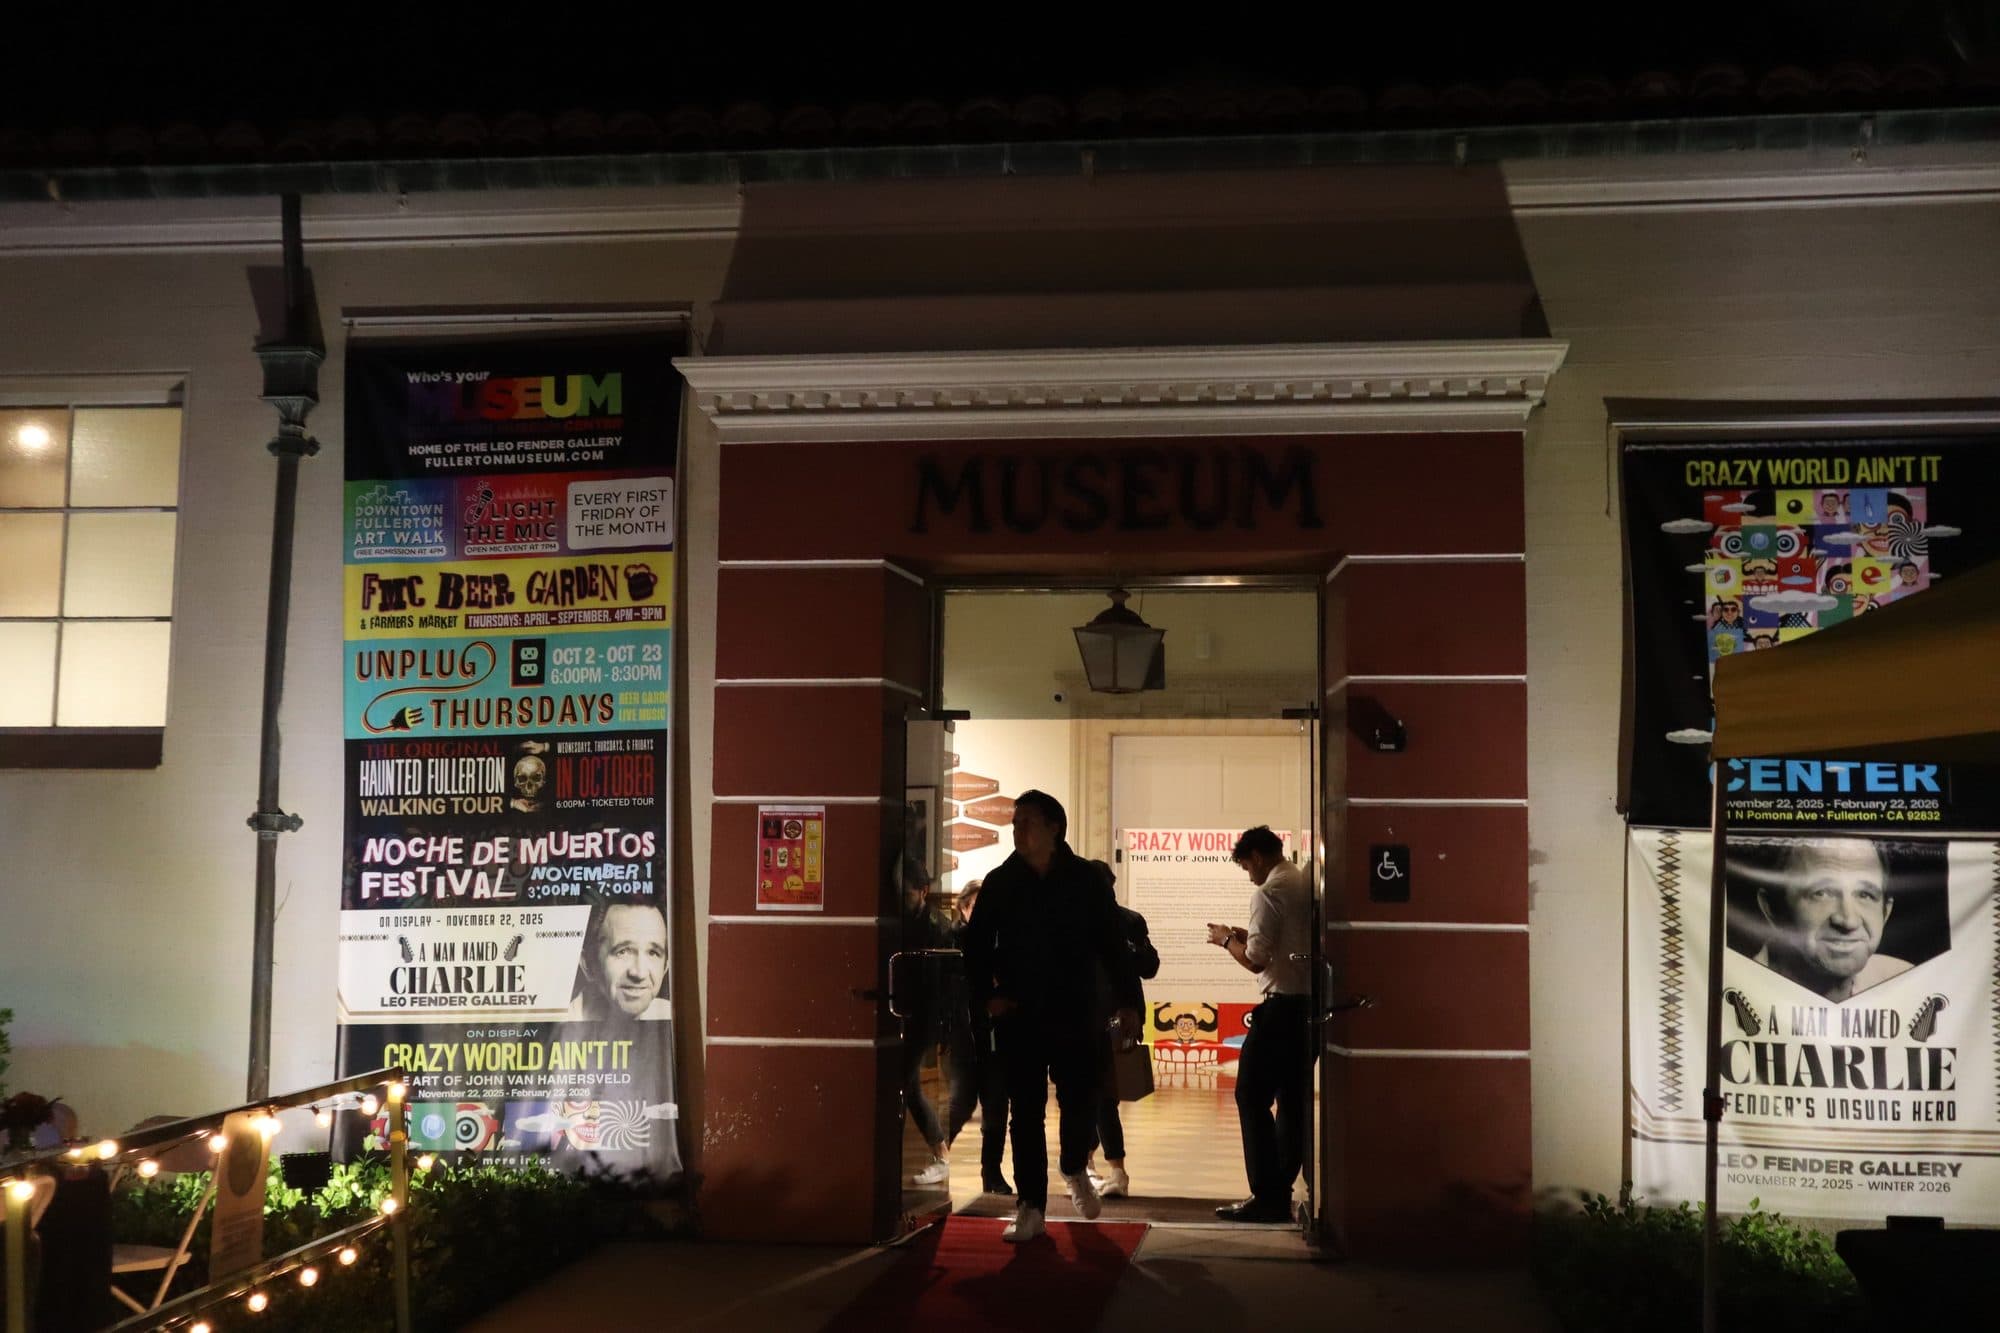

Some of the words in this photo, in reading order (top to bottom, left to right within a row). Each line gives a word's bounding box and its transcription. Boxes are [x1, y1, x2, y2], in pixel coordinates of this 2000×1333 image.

[407, 371, 453, 383] Who's
[456, 371, 490, 383] your
[408, 372, 622, 421] MUSEUM
[408, 444, 442, 455] HOME
[444, 443, 461, 454] OF
[463, 442, 488, 453] THE
[490, 441, 514, 452] LEO
[516, 439, 565, 451] FENDER
[567, 437, 622, 449] GALLERY
[425, 451, 604, 468] FULLERTONMUSEUM.COM
[1685, 459, 1763, 487] CRAZY
[1768, 457, 1850, 485] WORLD
[1855, 456, 1916, 483] AIN'T
[1920, 455, 1942, 482] IT
[574, 491, 622, 506] EVERY
[627, 488, 668, 502] FIRST
[907, 443, 1326, 535] MUSEUM
[356, 504, 443, 516] DOWNTOWN
[491, 500, 557, 521] LIGHT
[581, 507, 634, 521] FRIDAY
[639, 505, 660, 518] OF
[355, 517, 443, 529] FULLERTON
[464, 524, 506, 543] THE
[515, 521, 558, 541] MIC
[575, 523, 604, 536] THE
[608, 521, 666, 535] MONTH
[354, 531, 386, 545] ART
[394, 530, 444, 544] WALK
[374, 547, 416, 555] ADMISSION
[504, 544, 528, 552] EVENT
[529, 543, 538, 551] AT
[361, 573, 425, 612] FMC
[435, 572, 515, 609] BEER
[526, 564, 619, 607] GARDEN
[370, 615, 414, 629] FARMERS
[419, 615, 458, 629] MARKET
[467, 613, 522, 628] THURSDAYS:
[552, 647, 582, 665] OCT
[585, 648, 596, 664] 2
[607, 645, 637, 664] OCT
[642, 644, 662, 662] 23
[355, 648, 477, 682] UNPLUG
[551, 668, 602, 685] 6:00PM
[611, 665, 662, 681] 8:30PM
[429, 693, 615, 729] THURSDAYS
[366, 743, 400, 759] THE
[405, 740, 504, 758] ORIGINAL
[557, 741, 593, 754] WEDNESDAYS,
[594, 740, 625, 752] THURSDAYS,
[631, 738, 654, 751] FRIDAYS
[359, 758, 422, 797] HAUNTED
[427, 756, 506, 796] FULLERTON
[556, 755, 573, 799] IN
[579, 753, 655, 798] OCTOBER
[1709, 758, 1942, 793] CENTER
[360, 797, 447, 816] WALKING
[450, 796, 504, 815] TOUR
[556, 800, 586, 809] 6:00PM
[591, 799, 631, 808] TICKETED
[632, 797, 655, 806] TOUR
[1726, 799, 1774, 809] vember
[1775, 799, 1794, 810] 22,
[1796, 799, 1825, 809] 2025
[1833, 799, 1887, 811] February
[1889, 799, 1909, 810] 22,
[1910, 799, 1939, 809] 2026
[1735, 811, 1744, 821] N
[1747, 811, 1793, 821] Pomona
[1795, 811, 1818, 821] Ave
[1827, 810, 1877, 821] Fullerton
[1886, 811, 1904, 821] CA
[1906, 811, 1941, 821] 92832
[363, 835, 464, 866] NOCHE
[471, 836, 510, 866] DE
[519, 827, 656, 865] MUERTOS
[1128, 831, 1183, 852] CRAZY
[1130, 854, 1149, 862] THE
[1152, 854, 1172, 862] ART
[1175, 854, 1189, 862] OF
[1191, 855, 1219, 863] JOHN
[530, 863, 641, 882] NOVEMBER
[645, 863, 652, 879] 1
[360, 866, 517, 900] FESTIVAL
[528, 882, 581, 899] 3:00PM
[598, 880, 654, 897] 7:00PM
[379, 916, 391, 928] ON
[393, 915, 432, 928] DISPLAY
[446, 914, 495, 927] NOVEMBER
[499, 913, 516, 928] 22,
[519, 913, 544, 926] 2025
[418, 944, 426, 962] A
[433, 942, 456, 962] MAN
[461, 941, 499, 962] NAMED
[389, 964, 526, 995] CHARLIE
[380, 996, 408, 1008] LEO
[410, 995, 468, 1007] FENDER
[470, 994, 538, 1006] GALLERY
[1768, 1004, 1779, 1036] A
[1791, 1005, 1829, 1037] MAN
[1841, 1007, 1900, 1040] NAMED
[466, 1029, 485, 1039] ON
[487, 1028, 539, 1038] DISPLAY
[383, 1043, 460, 1073] CRAZY
[463, 1041, 544, 1072] WORLD
[548, 1040, 611, 1071] AIN'T
[611, 1040, 633, 1070] IT
[1719, 1039, 1957, 1092] CHARLIE
[412, 1075, 439, 1086] ART
[443, 1075, 462, 1086] OF
[466, 1075, 503, 1086] JOHN
[506, 1075, 534, 1086] VAN
[537, 1073, 632, 1085] HAMERSVELD
[418, 1089, 466, 1099] November
[467, 1089, 482, 1100] 22,
[483, 1088, 505, 1098] 2025
[511, 1087, 551, 1099] February
[552, 1087, 567, 1098] 22,
[568, 1087, 591, 1098] 2026
[1722, 1091, 1816, 1119] FENDER'S
[1827, 1097, 1901, 1122] UNSUNG
[1912, 1100, 1957, 1122] HERO
[482, 1156, 516, 1165] more
[1717, 1153, 1758, 1169] LEO
[1763, 1155, 1855, 1177] FENDER
[1859, 1159, 1963, 1179] GALLERY
[1727, 1173, 1797, 1188] NOVEMBER
[1800, 1177, 1819, 1191] 22,
[1822, 1178, 1853, 1190] 2025
[1867, 1180, 1915, 1193] WINTER
[1918, 1181, 1951, 1193] 2026
